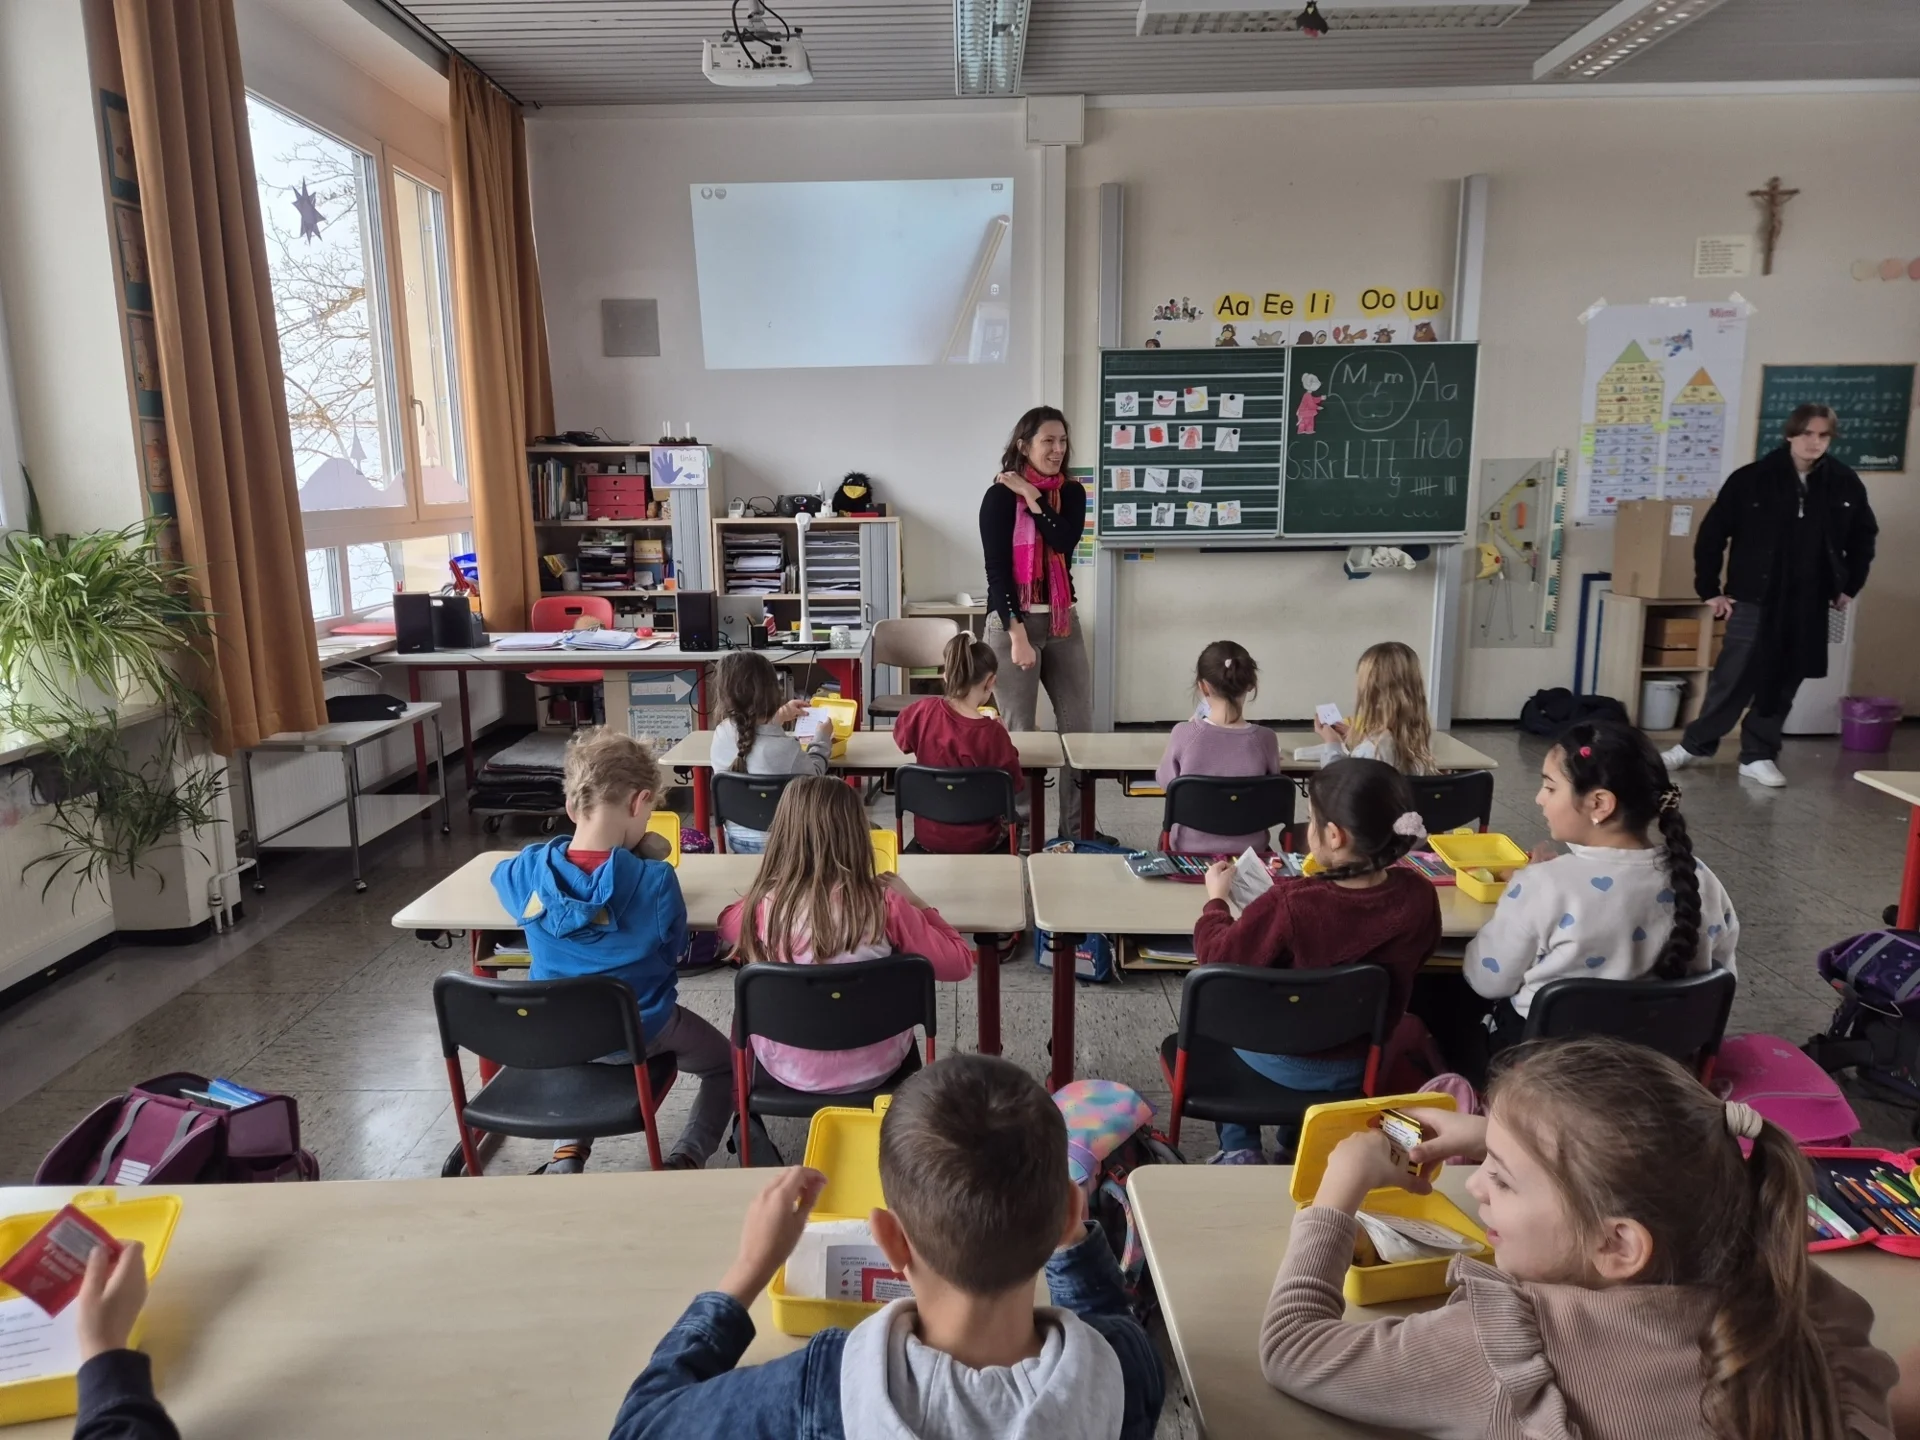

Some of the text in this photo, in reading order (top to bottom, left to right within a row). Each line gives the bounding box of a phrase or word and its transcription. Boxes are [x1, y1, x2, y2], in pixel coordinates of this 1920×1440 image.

[1217, 295, 1250, 316] Aa
[1263, 293, 1294, 315] Ee
[1361, 289, 1395, 310] Oo
[1406, 291, 1439, 311] Uu
[1416, 361, 1459, 401] Aa
